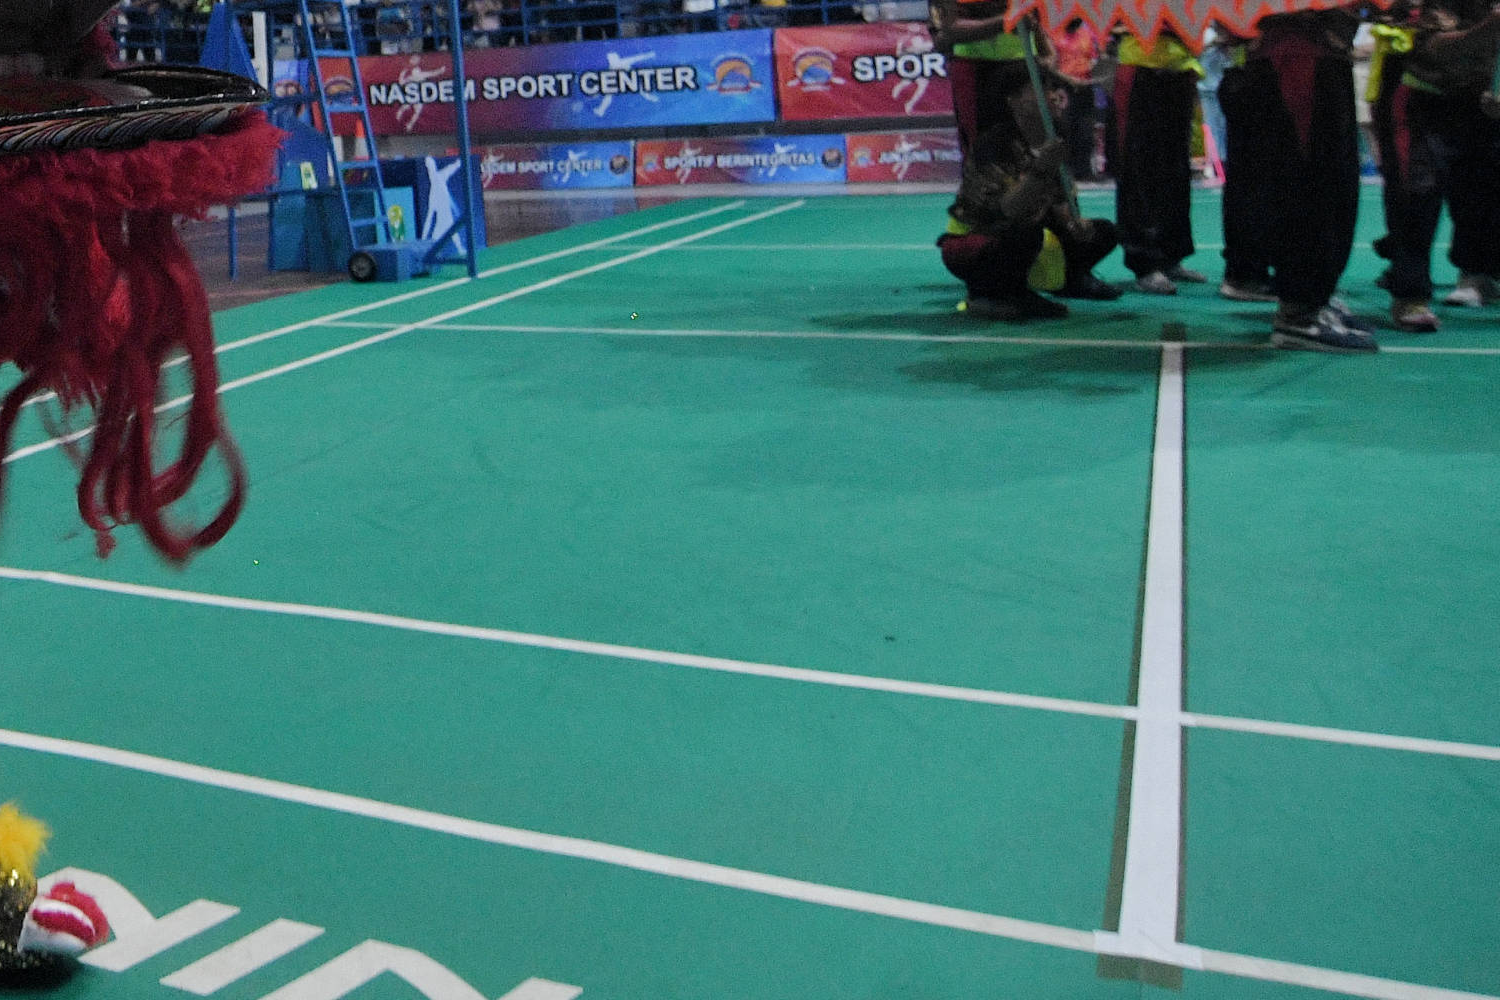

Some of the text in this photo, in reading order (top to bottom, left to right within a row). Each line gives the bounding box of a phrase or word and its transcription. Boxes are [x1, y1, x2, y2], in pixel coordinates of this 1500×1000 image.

[482, 73, 573, 100] SPORT
[580, 66, 696, 95] CENTER
[852, 52, 946, 83] SPOR
